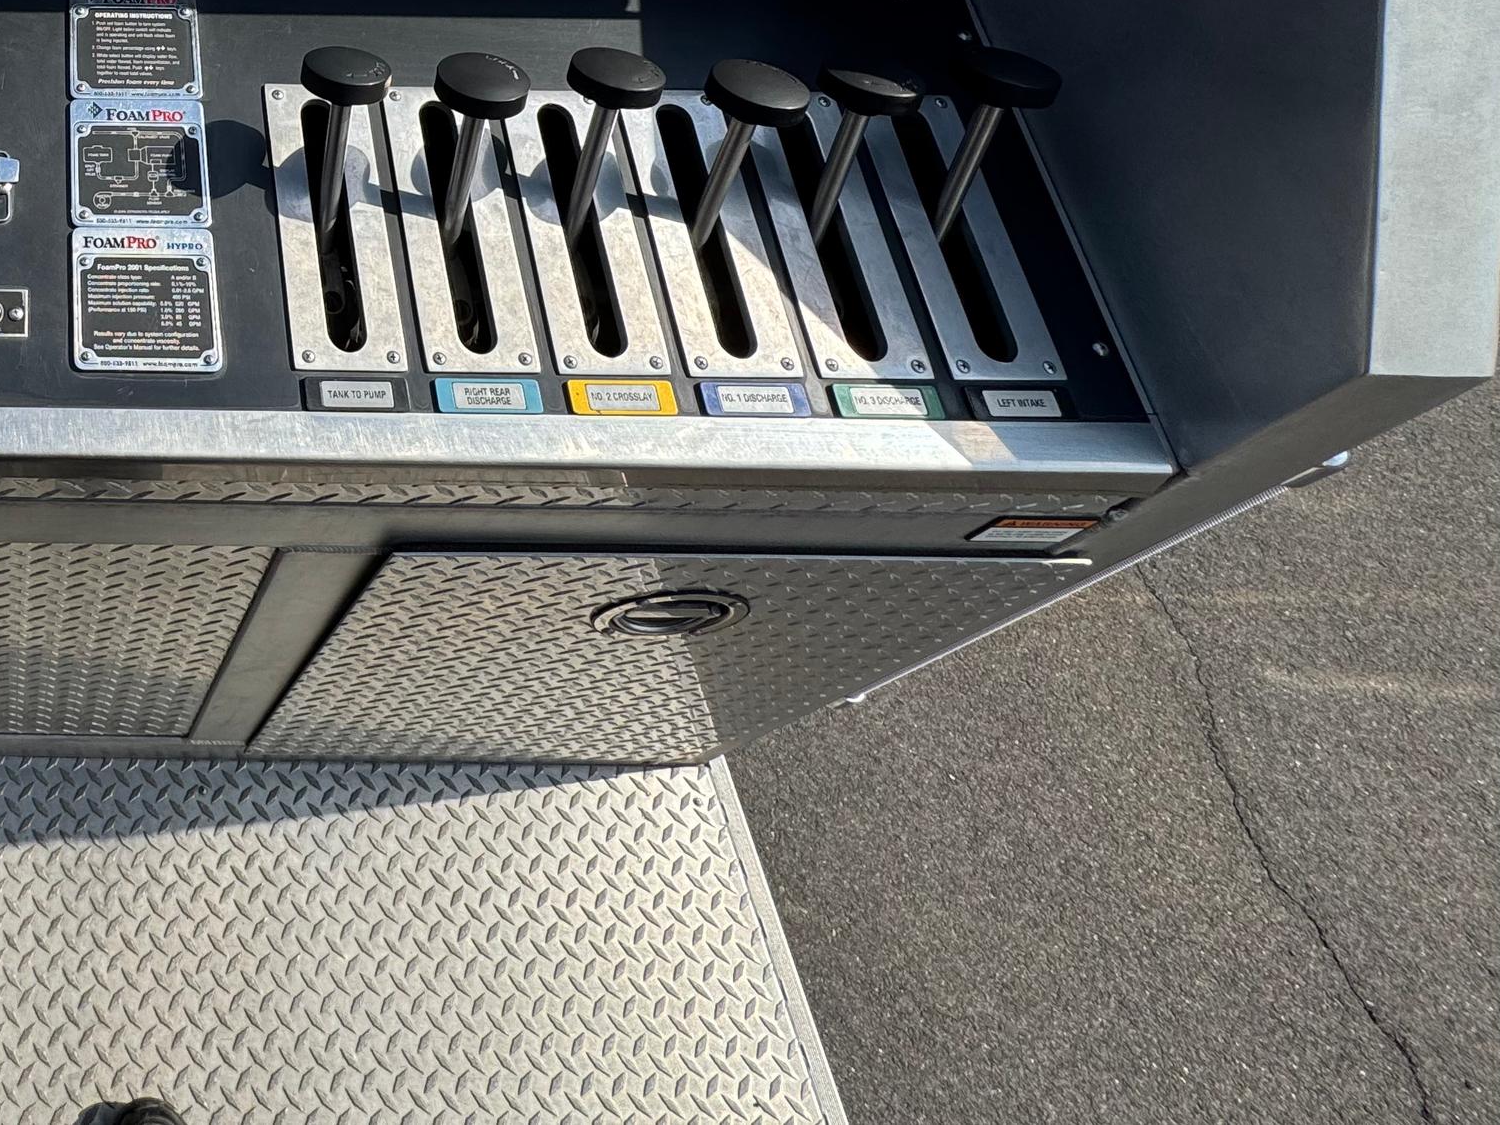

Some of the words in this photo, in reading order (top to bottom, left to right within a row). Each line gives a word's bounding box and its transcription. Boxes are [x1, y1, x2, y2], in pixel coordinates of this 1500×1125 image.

[94, 12, 128, 20] OPERATING
[129, 12, 173, 20] INSTRUCTIONS
[166, 242, 203, 250] HYPRO
[97, 264, 126, 272] FoamPro
[144, 264, 190, 272] Specifications
[327, 390, 348, 400] TANK
[349, 390, 362, 400] TO
[364, 390, 386, 400] PUMP
[465, 387, 487, 397] RIGHT
[489, 387, 511, 397] REAR
[605, 392, 611, 402] 2
[612, 392, 652, 402] CROSSLAY
[467, 396, 512, 406] DISCHARGE
[743, 393, 788, 403] DISCHARGE
[870, 395, 877, 406] 3
[877, 395, 921, 406] DISCHARGE
[996, 398, 1017, 409] LEFT
[1018, 398, 1047, 409] INTAKE
